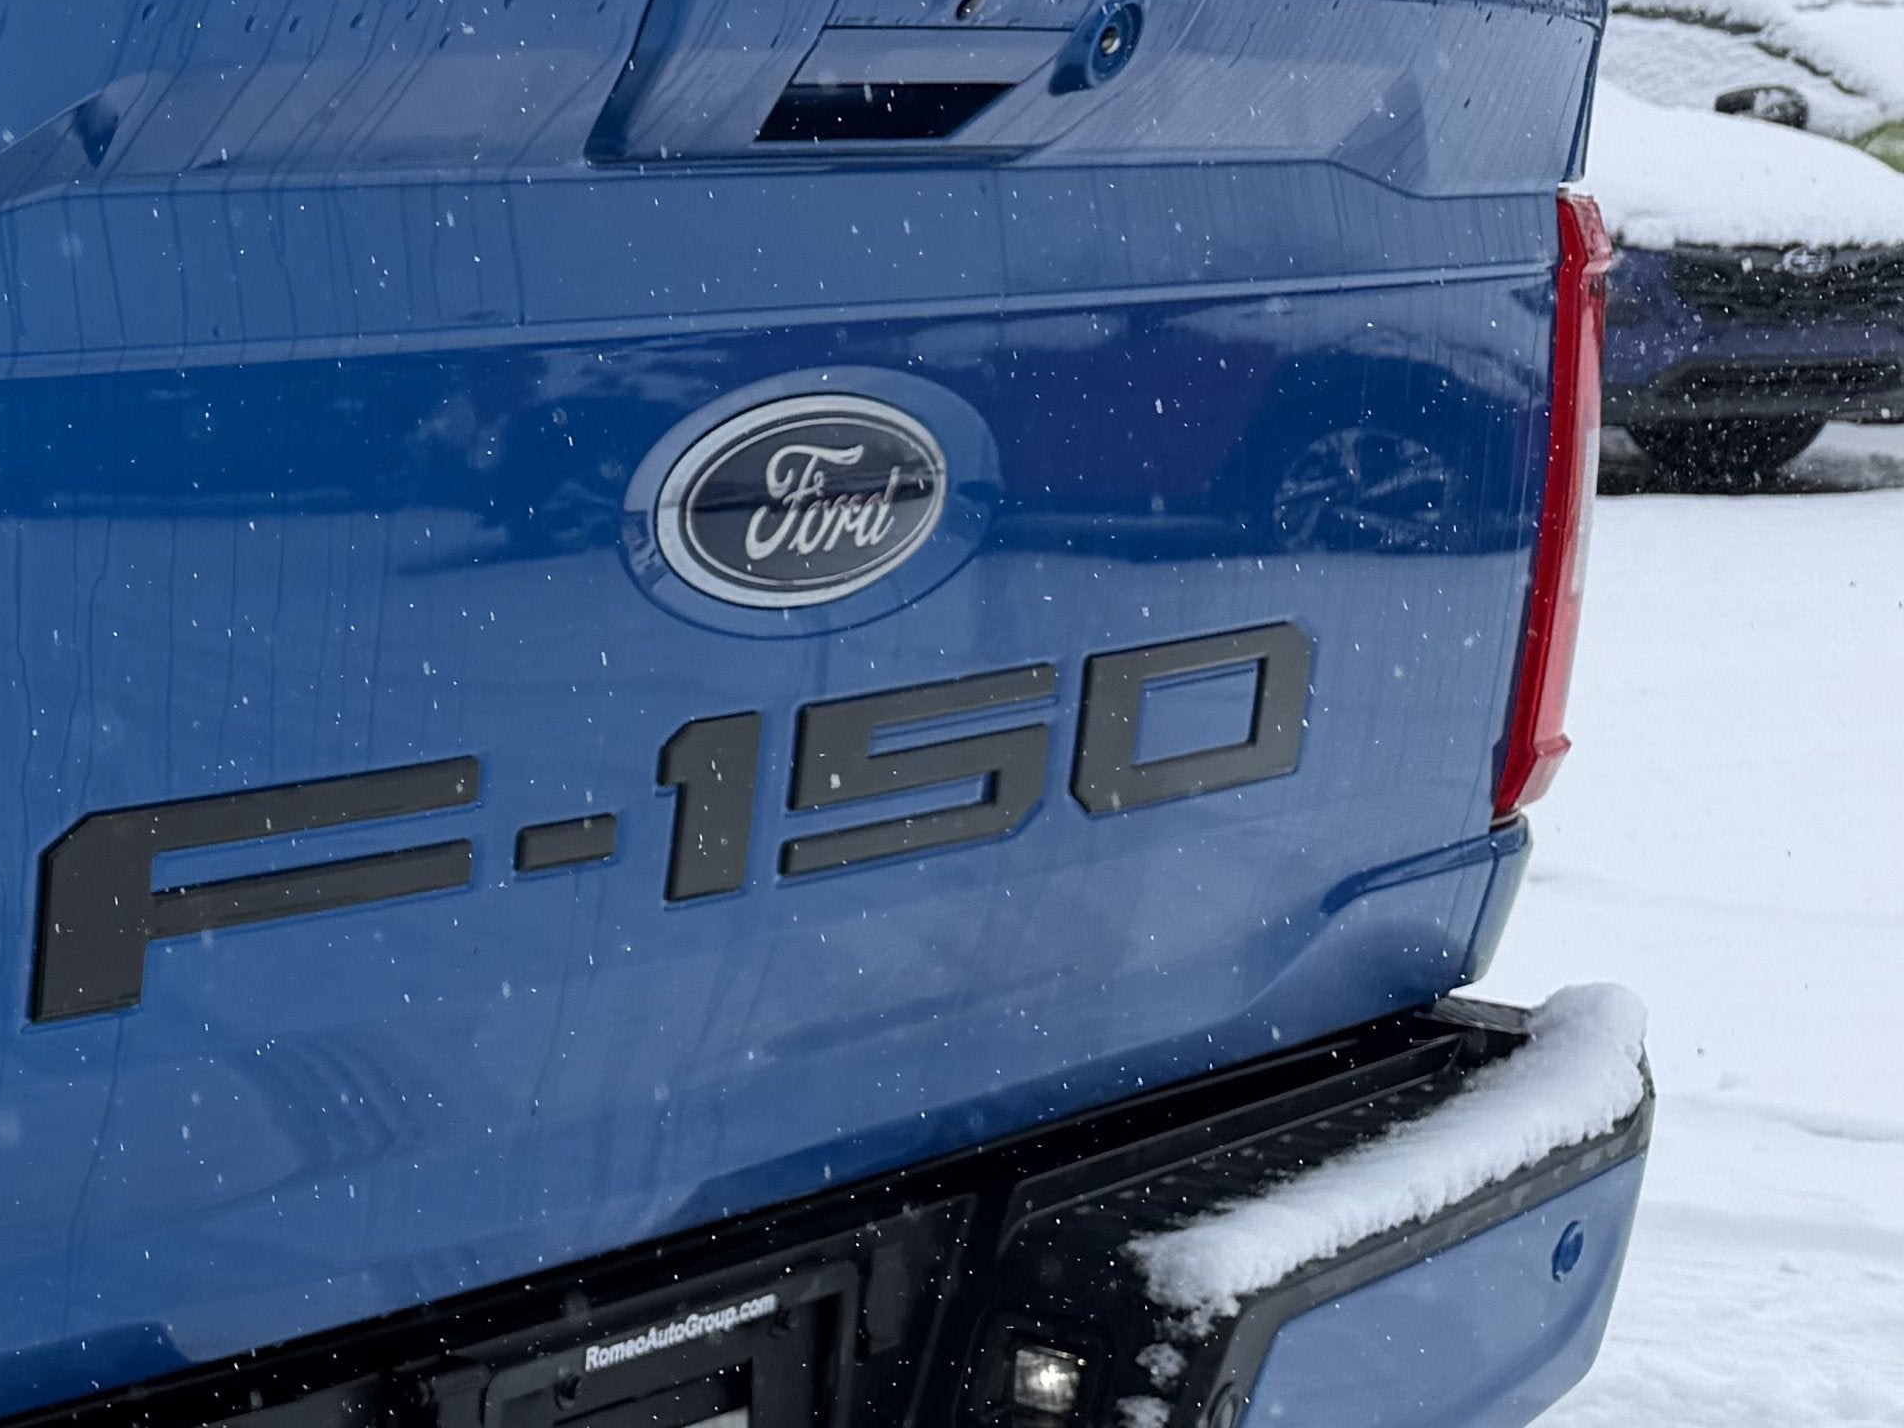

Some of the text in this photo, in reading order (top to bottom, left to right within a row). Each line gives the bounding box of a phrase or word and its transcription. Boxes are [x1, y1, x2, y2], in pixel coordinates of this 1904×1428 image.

[745, 445, 900, 559] Ford
[29, 620, 1316, 1025] F-150
[585, 1293, 777, 1371] RomeoAutoGroup.com
